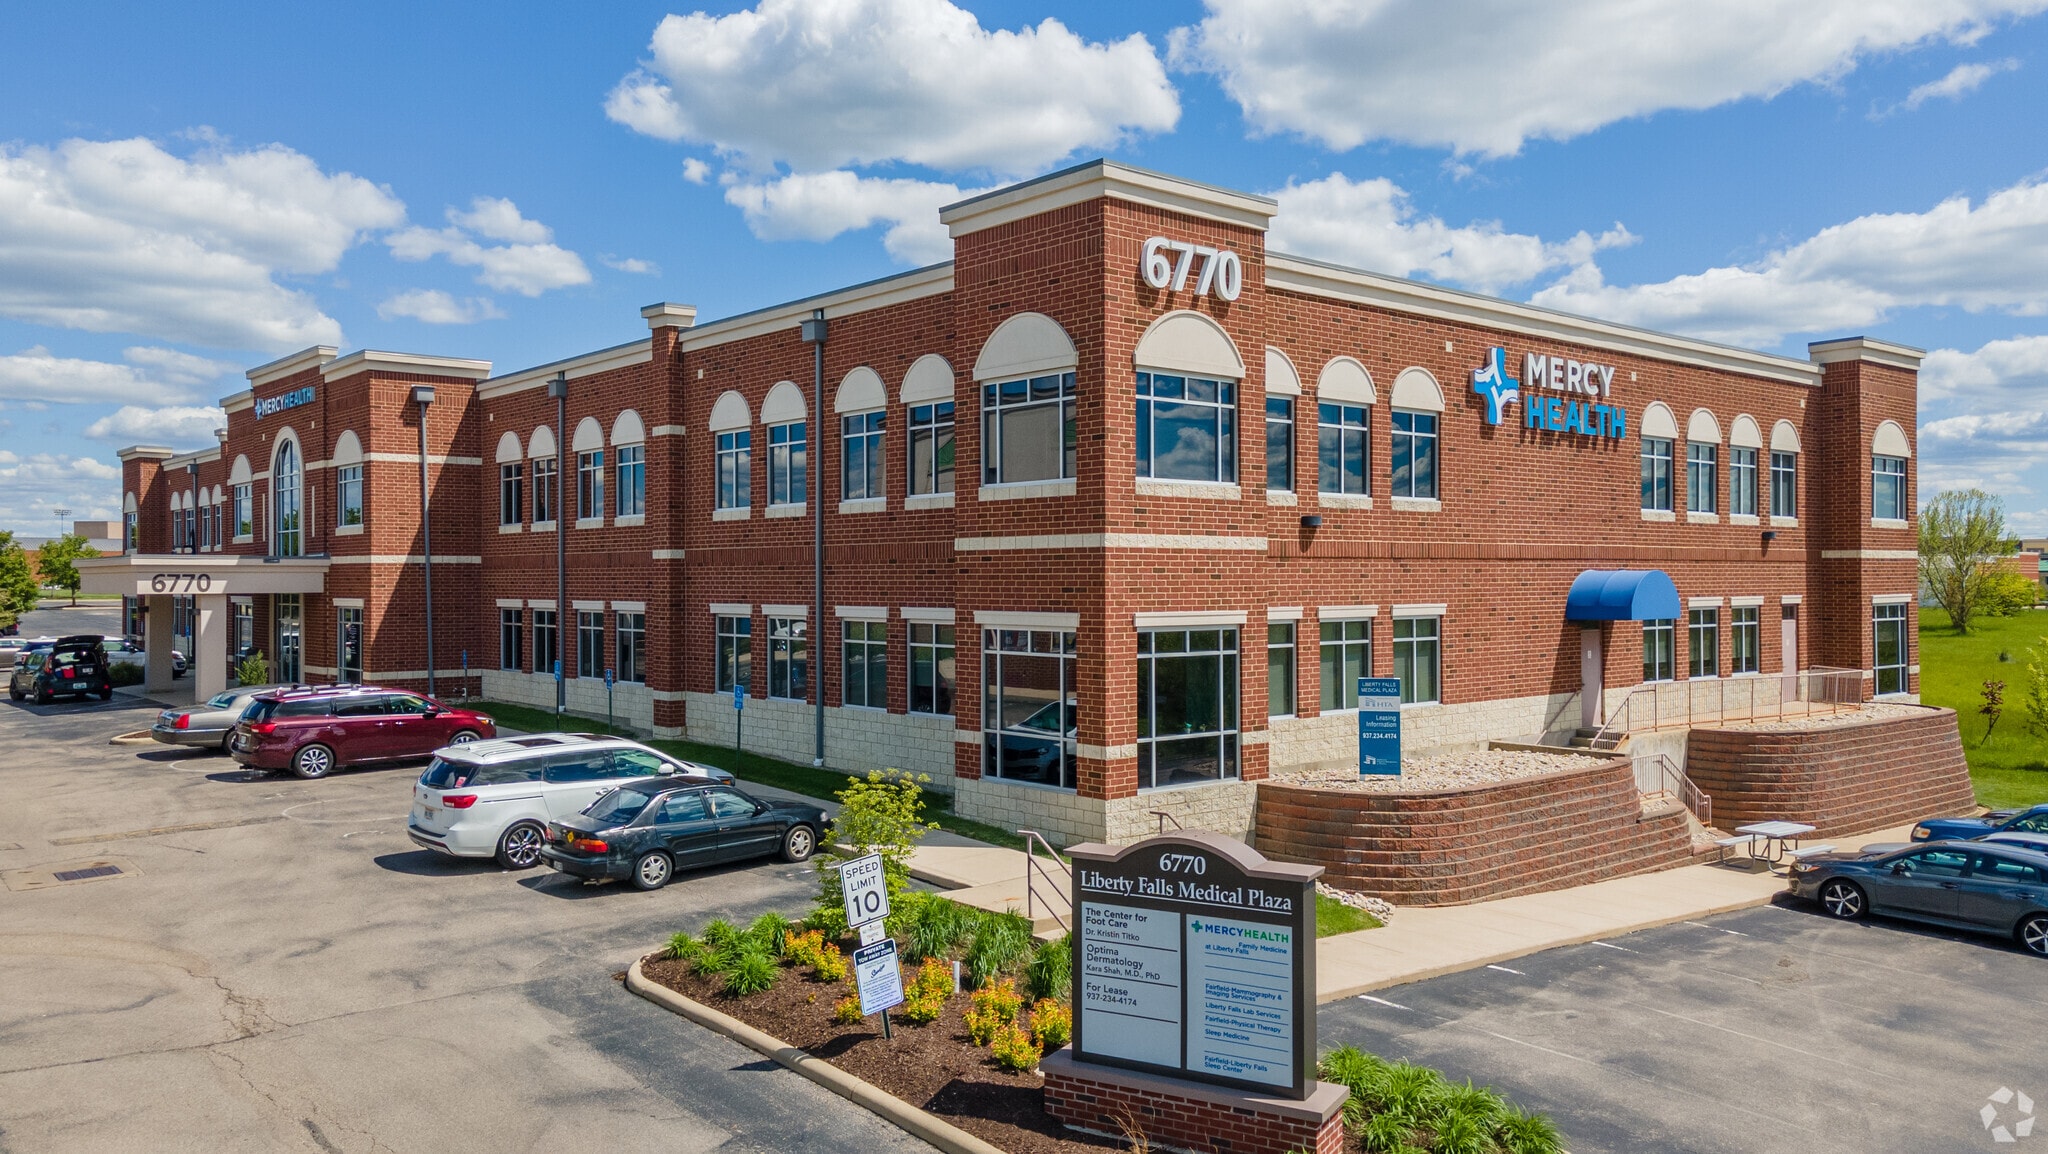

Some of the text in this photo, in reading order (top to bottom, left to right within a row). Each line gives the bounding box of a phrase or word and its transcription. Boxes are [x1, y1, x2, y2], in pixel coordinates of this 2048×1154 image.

[1141, 236, 1242, 302] 6770
[1522, 352, 1615, 397] MERCY
[261, 385, 316, 416] MERCYHEALTH
[1522, 395, 1626, 439] HEALTH
[151, 573, 211, 593] 6770
[1375, 714, 1397, 722] Leasing
[845, 861, 879, 879] SPEED
[1159, 853, 1206, 875] 6770
[850, 876, 877, 892] LIMIT
[1080, 870, 1292, 911] Liberty Falls Medical Plaza
[853, 890, 880, 918] 10
[1085, 907, 1148, 923] The Center for
[1085, 916, 1128, 929] Foot Care
[1085, 928, 1140, 941] Dr. Kristin Titko
[1205, 923, 1289, 944] MERCYHEALTH
[858, 956, 869, 964] TOW
[868, 952, 882, 961] AWAY
[880, 947, 893, 957] ZONE
[863, 943, 886, 956] PRIVATE
[1086, 943, 1119, 956] Optima
[1213, 944, 1234, 953] Liberty
[1235, 947, 1249, 955] Falls
[1238, 941, 1288, 954] Family Medicine
[1086, 953, 1144, 970] Dermatology
[1086, 964, 1161, 981] Kara Shah, M.D., PhD
[1086, 982, 1129, 996] For Lease
[1205, 983, 1276, 1000] Fairfield-Mammography
[1205, 989, 1256, 1002] Imaging Services
[1086, 992, 1137, 1006] 937-234-4174
[1205, 1002, 1227, 1011] Liberty
[1228, 1005, 1242, 1013] Falls
[1256, 1010, 1281, 1020] Services
[1205, 1015, 1281, 1034] Fairfield-Physical Therapy
[1205, 1028, 1250, 1041] Sleep Medicine
[1204, 1055, 1268, 1072] Fairfield-Liberty Falls
[1204, 1061, 1243, 1074] Sleep Center
